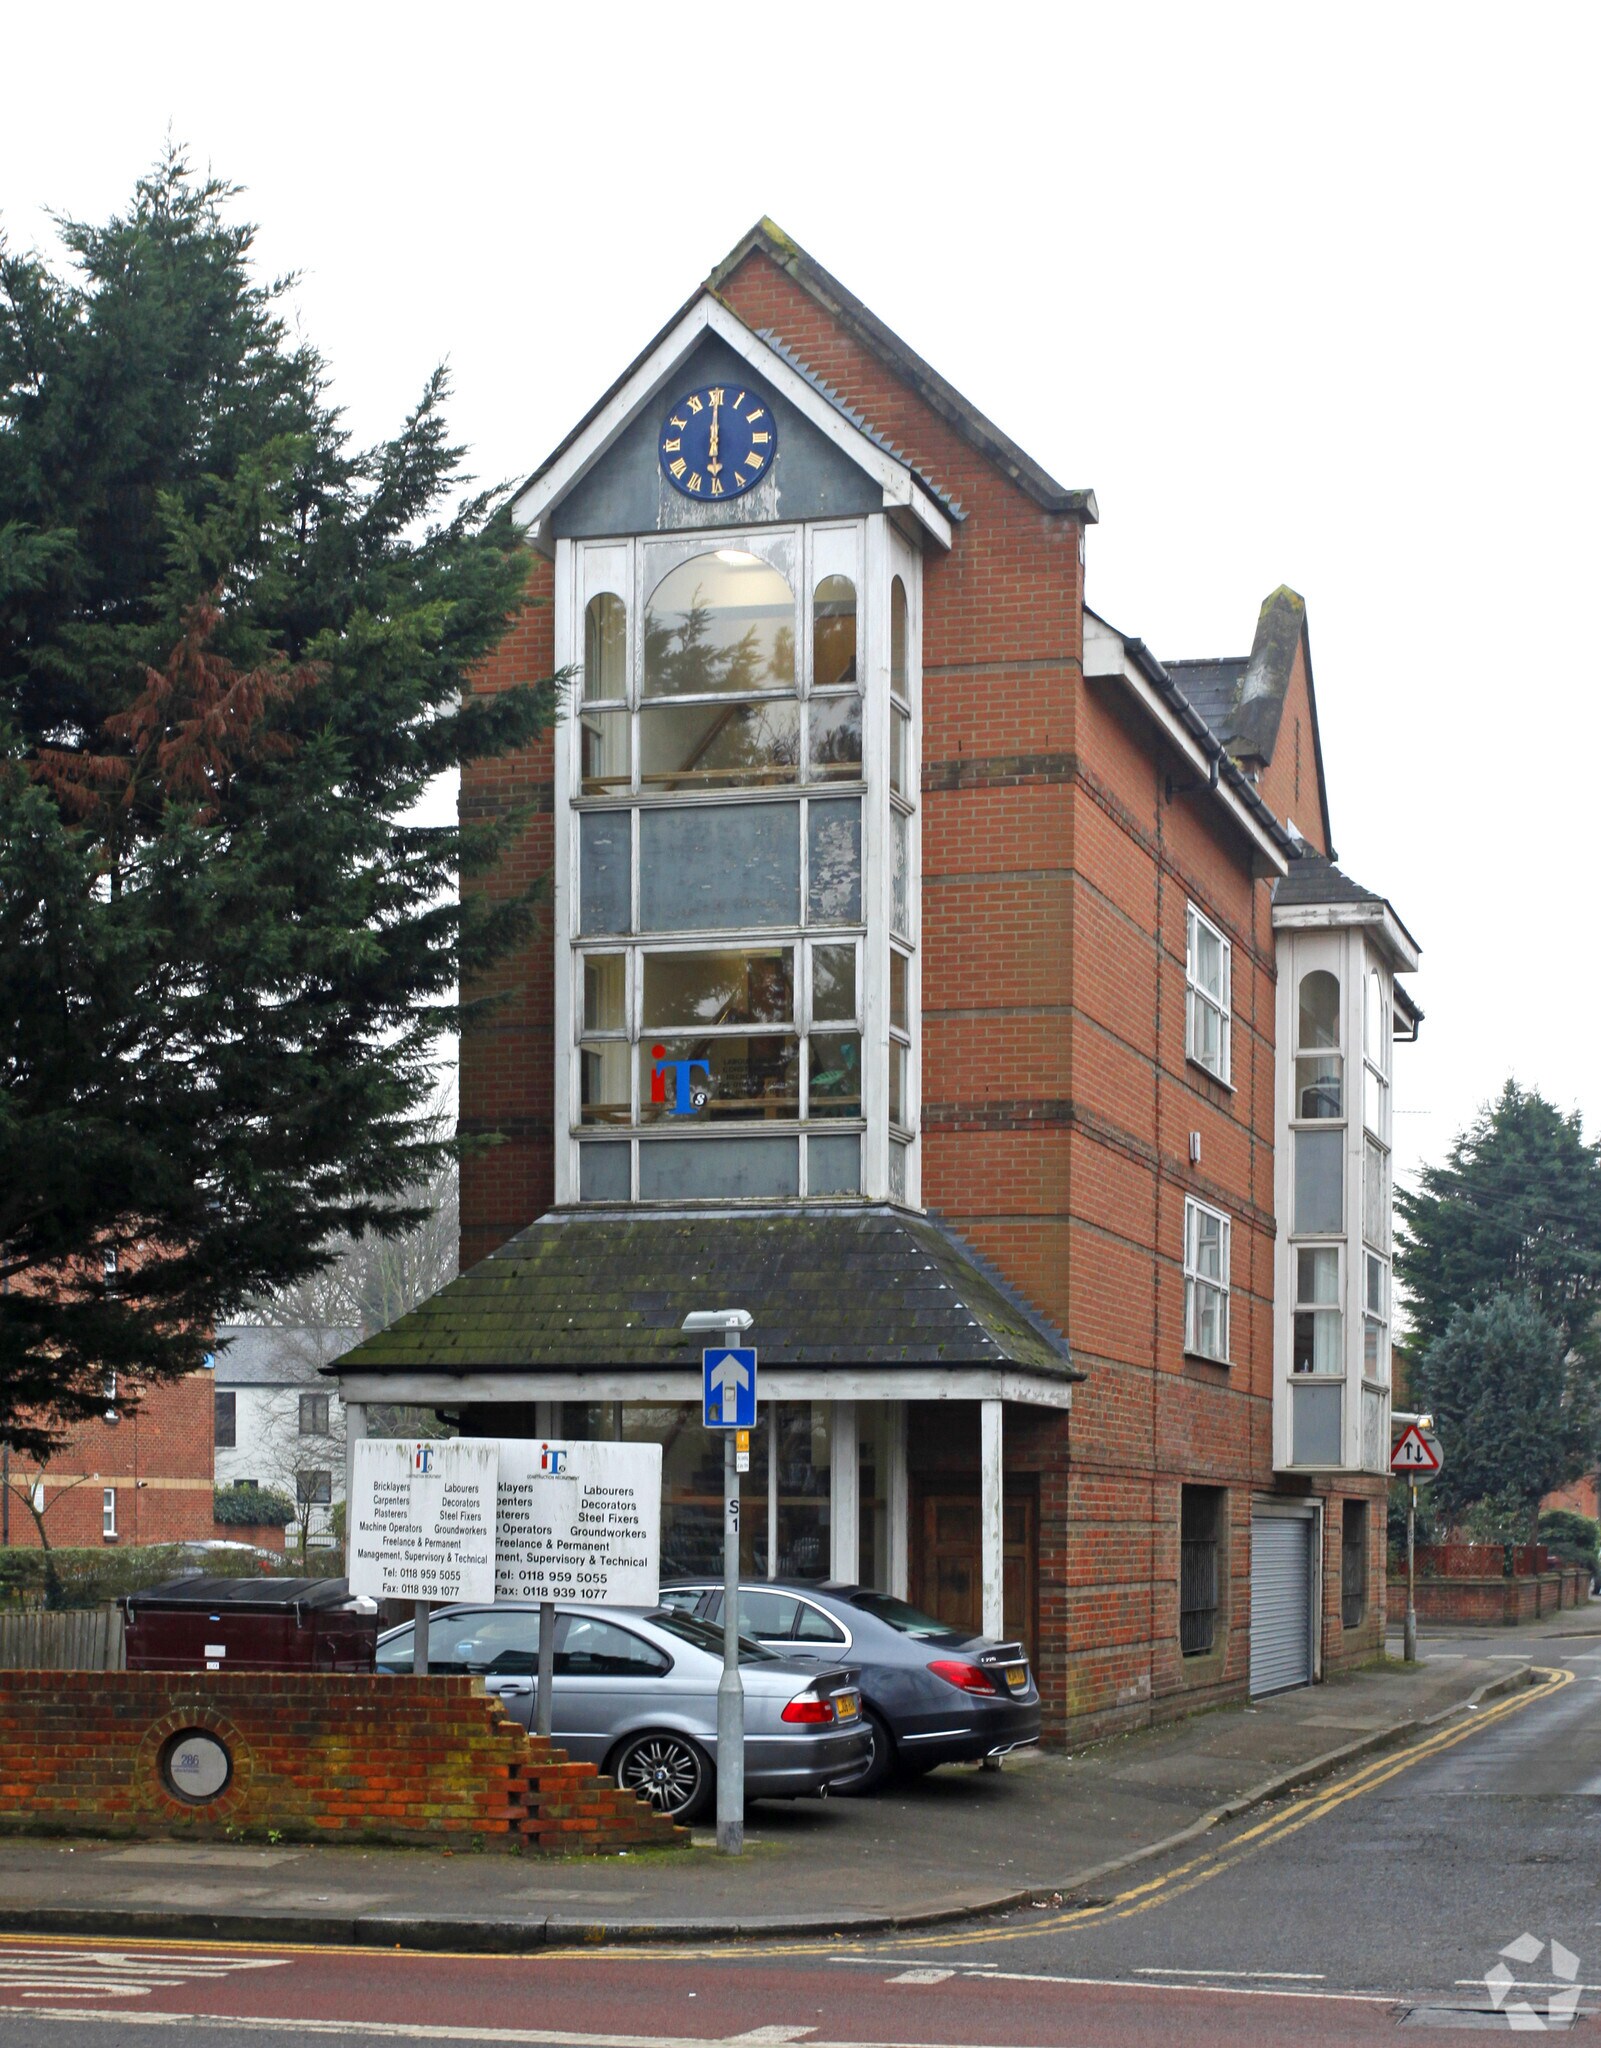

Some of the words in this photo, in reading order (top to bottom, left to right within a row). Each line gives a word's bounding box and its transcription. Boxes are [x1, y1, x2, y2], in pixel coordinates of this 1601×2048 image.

[374, 1481, 410, 1493] Bricklayers
[444, 1483, 479, 1493] Labourers
[584, 1485, 634, 1496] Labourers
[374, 1495, 410, 1506] Carpenters
[442, 1497, 480, 1508] Decorators
[582, 1499, 637, 1510] Decorators
[374, 1508, 407, 1518] Plasterers
[729, 1500, 740, 1514] S
[440, 1510, 457, 1520] Steel
[460, 1511, 482, 1521] Fixers
[579, 1513, 604, 1523] Steel
[608, 1514, 639, 1524] Fixers
[360, 1522, 386, 1532] Machine
[389, 1523, 422, 1534] Operators
[434, 1524, 487, 1535] Groundworkers
[502, 1524, 552, 1537] Operators
[732, 1518, 738, 1533] 1
[570, 1526, 647, 1538] Groundworkers
[383, 1536, 415, 1546] Freelance
[418, 1537, 422, 1546] &
[425, 1538, 461, 1548] Permanent
[496, 1537, 542, 1548] Freelance
[546, 1539, 552, 1549] &
[557, 1540, 610, 1551] Permanent
[358, 1549, 402, 1561] Management,
[404, 1551, 444, 1564] Supervisory
[447, 1553, 452, 1562] &
[455, 1554, 488, 1564] Technical
[526, 1553, 585, 1567] Supervisory
[589, 1555, 596, 1565] &
[600, 1556, 648, 1567] Technical
[383, 1567, 397, 1577] Tel:
[400, 1568, 417, 1578] 0118
[420, 1569, 436, 1579] 959
[439, 1570, 460, 1580] 5055
[519, 1570, 544, 1581] 0118
[549, 1572, 572, 1582] 959
[577, 1573, 607, 1583] 5055
[382, 1583, 398, 1593] Fax:
[402, 1584, 418, 1594] 0118
[422, 1585, 437, 1595] 939
[441, 1586, 459, 1596] 1077
[495, 1585, 518, 1595] Fax:
[523, 1586, 548, 1596] 0118
[553, 1588, 576, 1598] 939
[581, 1589, 607, 1599] 1077
